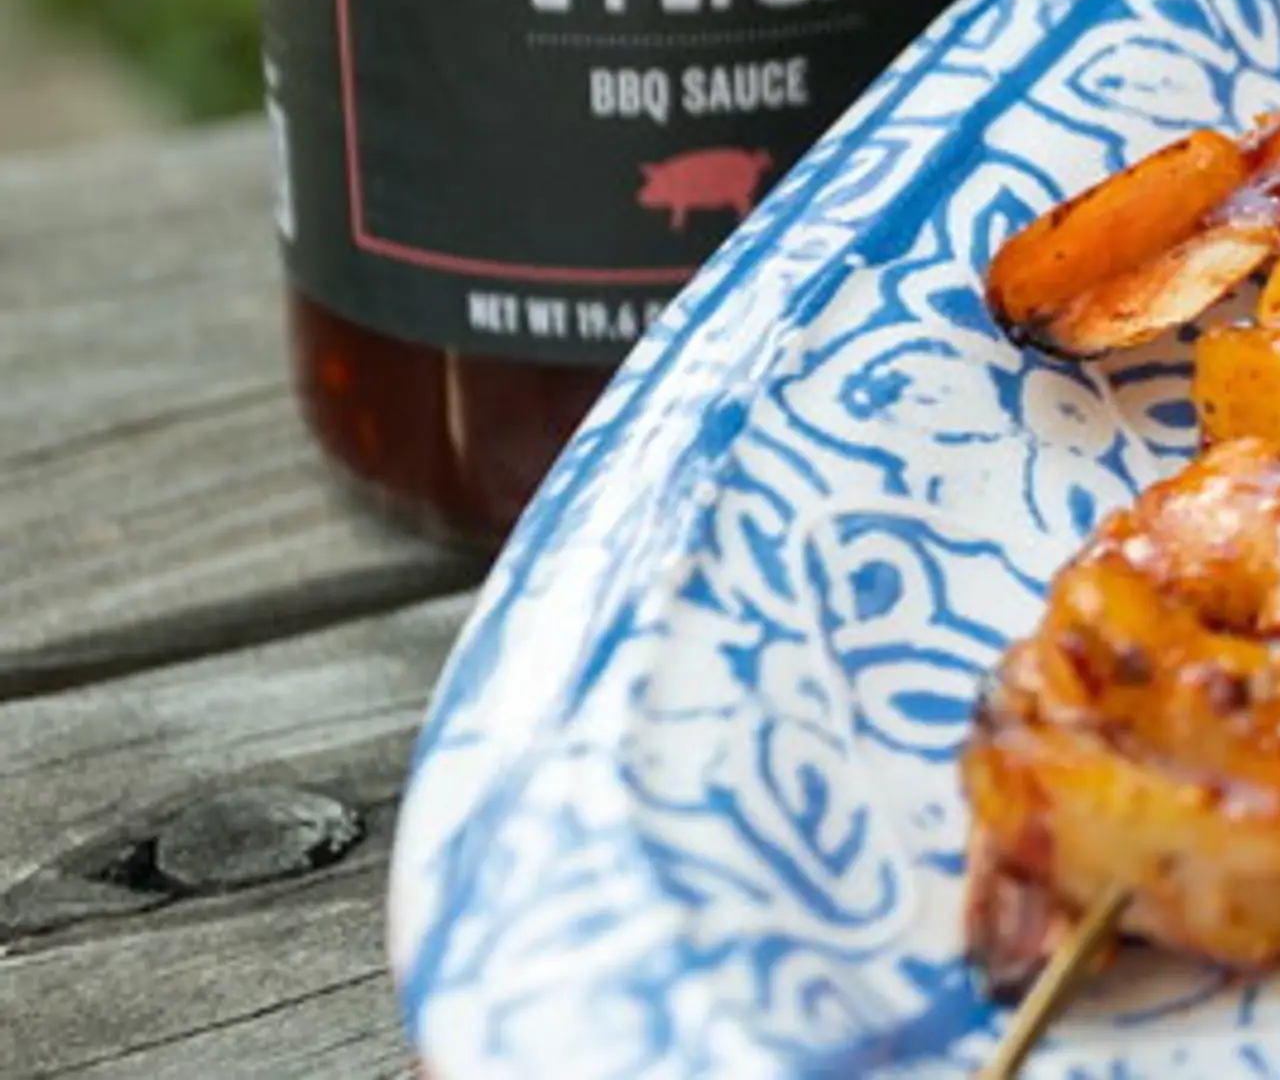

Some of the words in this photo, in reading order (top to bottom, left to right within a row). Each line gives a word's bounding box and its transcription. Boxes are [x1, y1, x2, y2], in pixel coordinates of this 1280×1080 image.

[589, 66, 671, 126] BBQ
[681, 56, 810, 116] SAUCE
[469, 290, 518, 335] NET
[526, 296, 567, 338] WT
